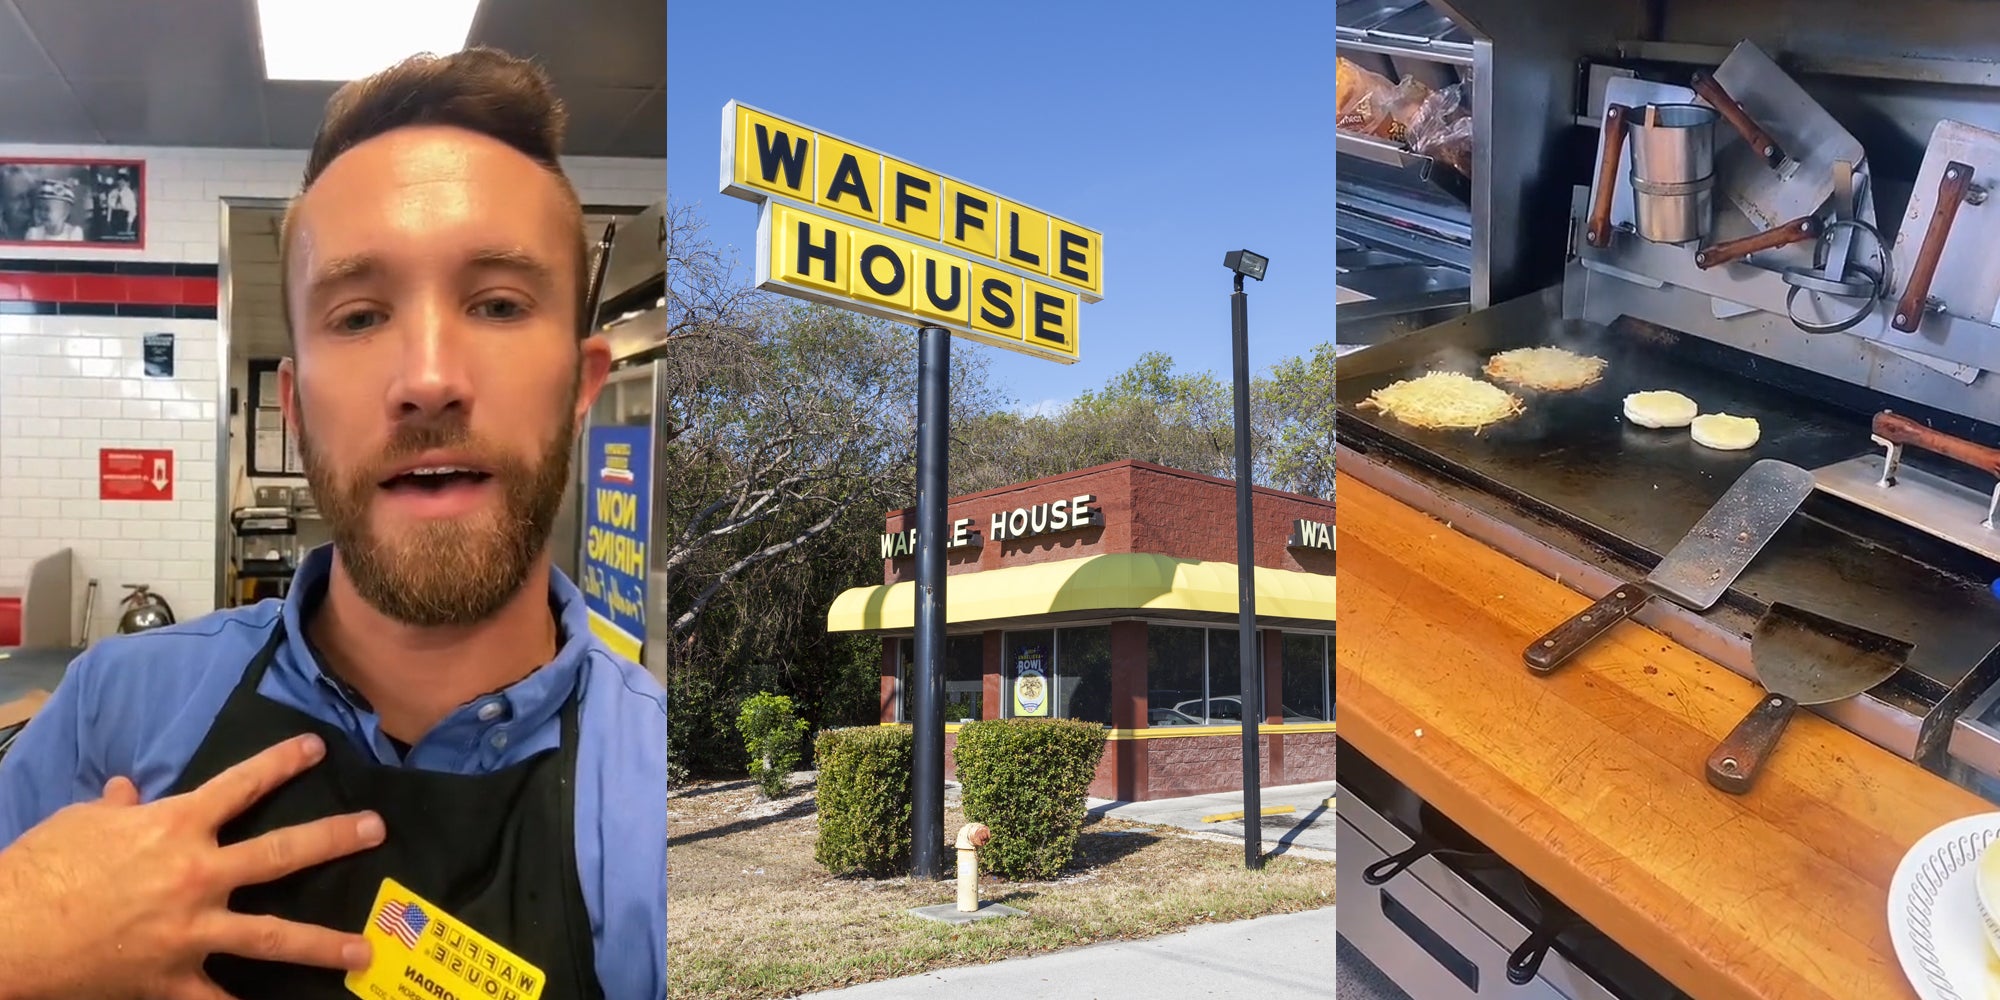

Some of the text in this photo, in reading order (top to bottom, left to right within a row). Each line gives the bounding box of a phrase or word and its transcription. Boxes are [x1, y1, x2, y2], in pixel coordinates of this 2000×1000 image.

[754, 123, 1089, 282] WAFFLE
[797, 221, 1066, 344] HOUSE
[881, 494, 1091, 559] WAFE HOUSE
[1018, 660, 1044, 674] BOWL
